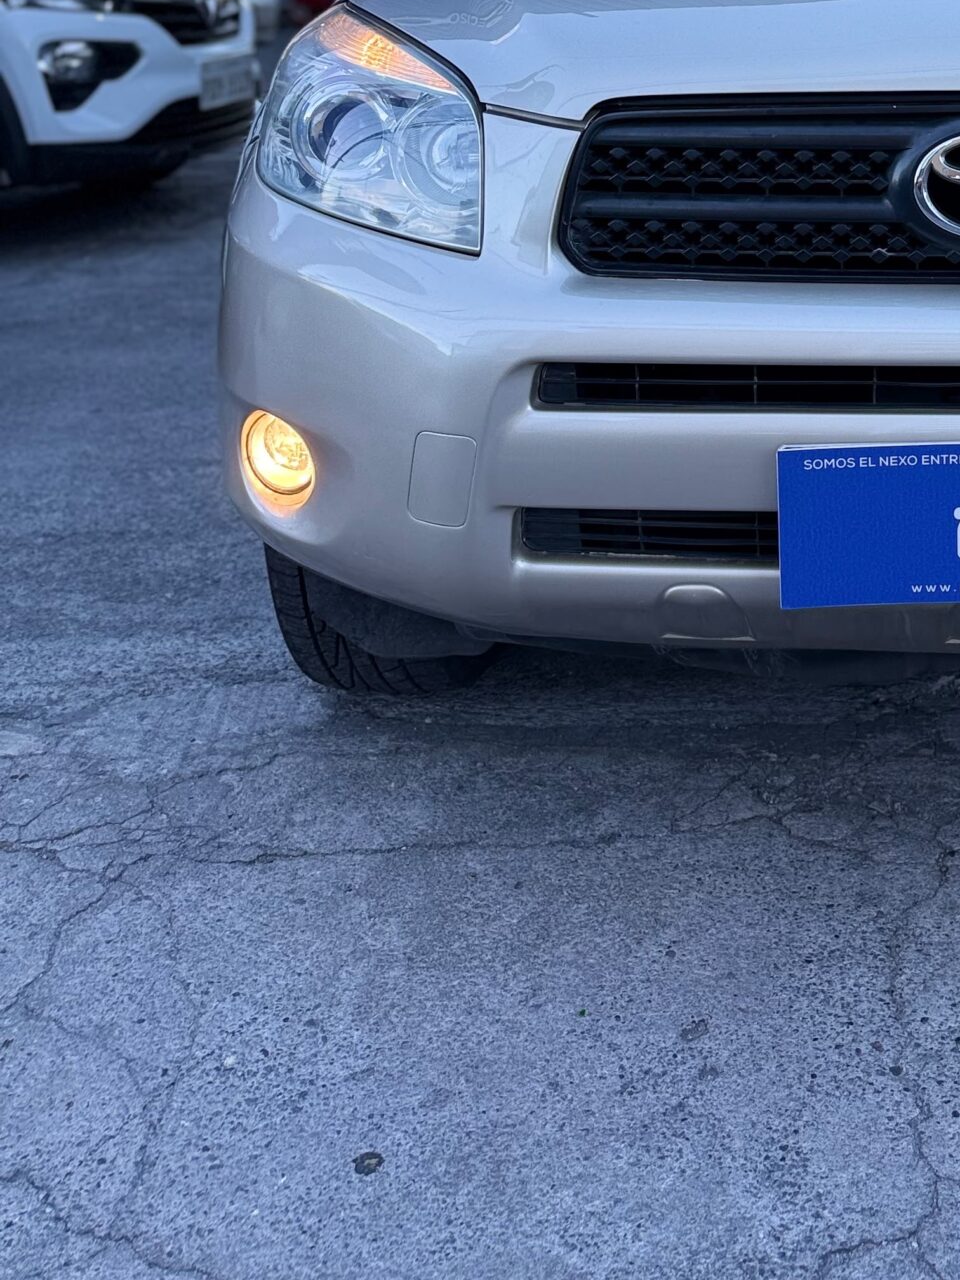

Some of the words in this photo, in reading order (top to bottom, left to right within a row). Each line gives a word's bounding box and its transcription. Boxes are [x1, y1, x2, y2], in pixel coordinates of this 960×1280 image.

[803, 457, 856, 471] SOMOS
[859, 457, 876, 468] EL
[879, 455, 918, 467] NEXO
